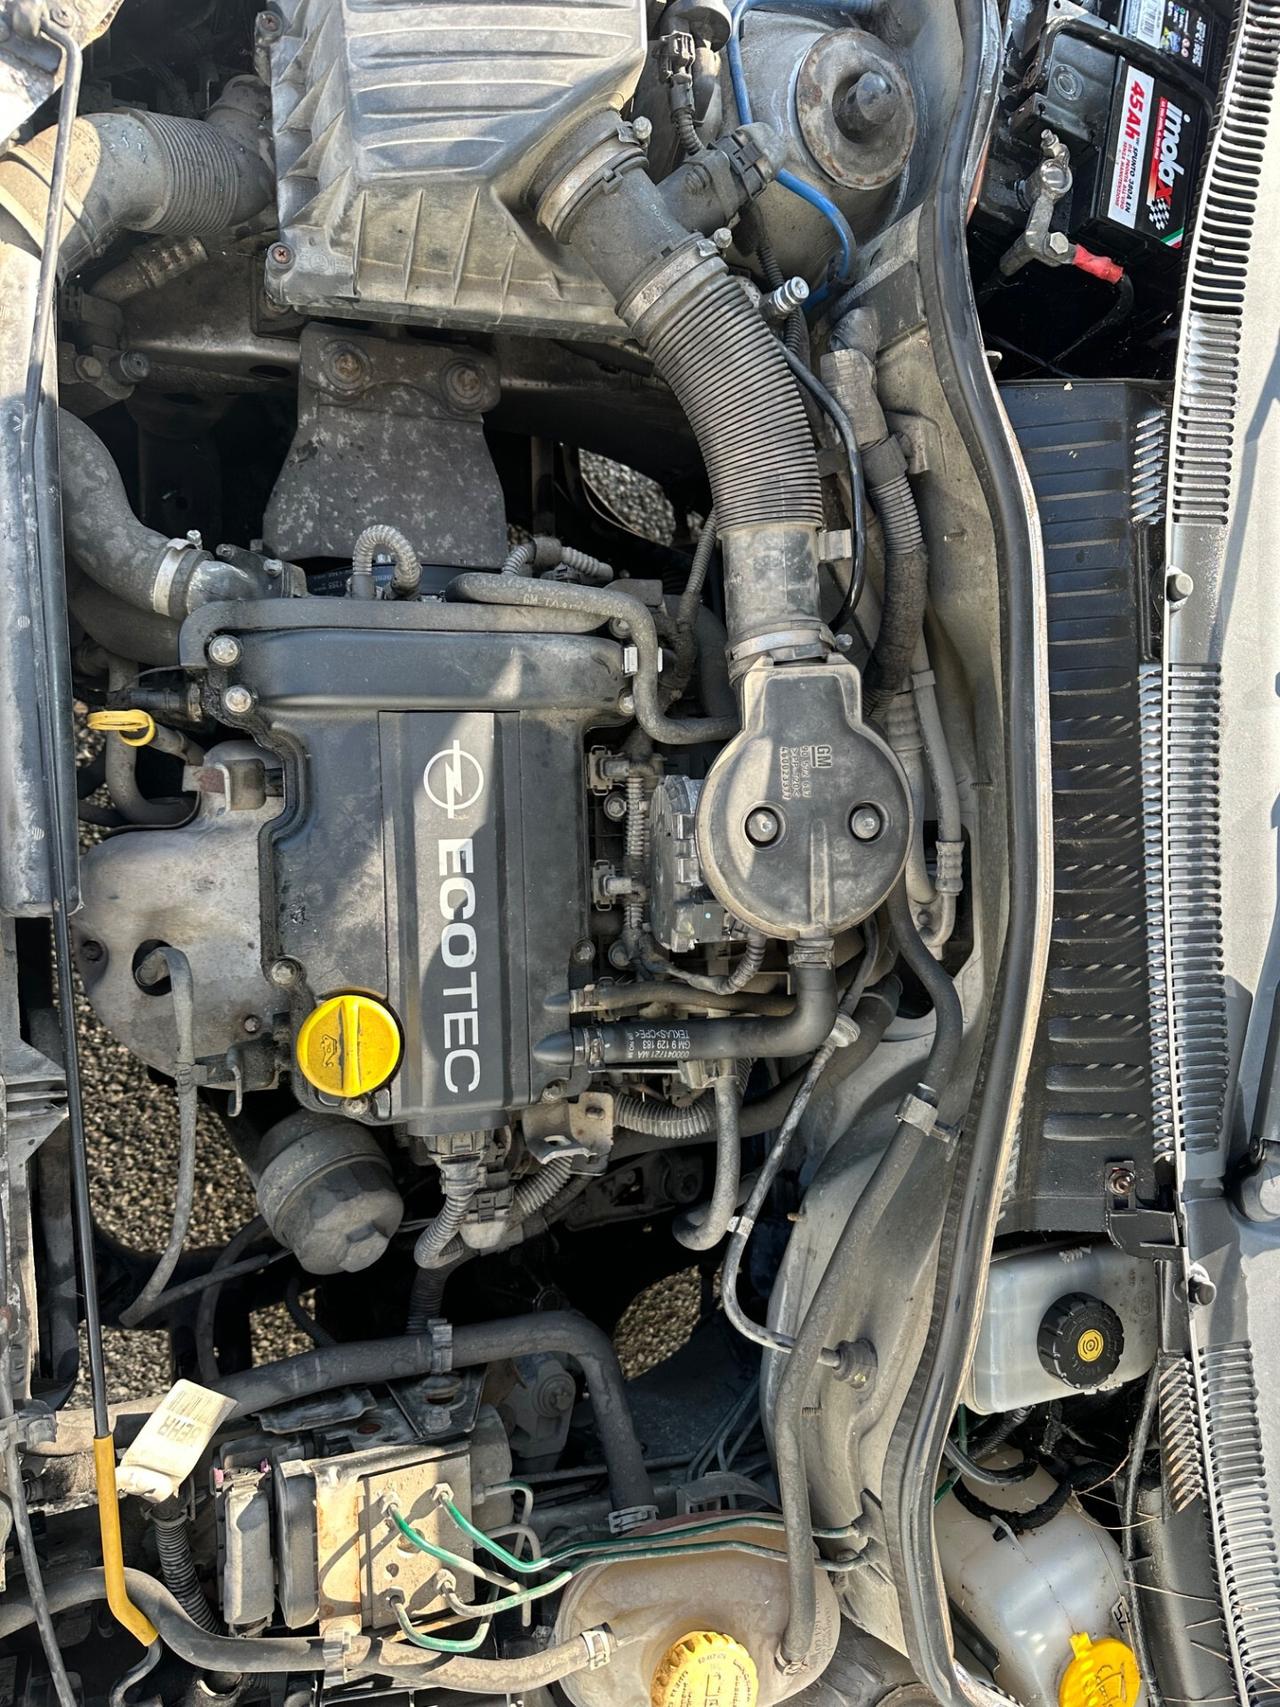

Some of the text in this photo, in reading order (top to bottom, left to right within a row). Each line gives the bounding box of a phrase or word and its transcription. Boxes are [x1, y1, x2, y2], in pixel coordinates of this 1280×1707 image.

[1124, 80, 1145, 140] 45Ah
[1128, 146, 1138, 178] SPUNTO
[1156, 103, 1191, 204] imolax
[1123, 158, 1131, 182] PRONTA
[1126, 178, 1134, 200] 380A
[1125, 201, 1132, 213] EN
[816, 745, 832, 768] GM
[438, 838, 481, 1094] ECOTEC
[657, 1040, 670, 1049] 129
[678, 1040, 691, 1049] GM
